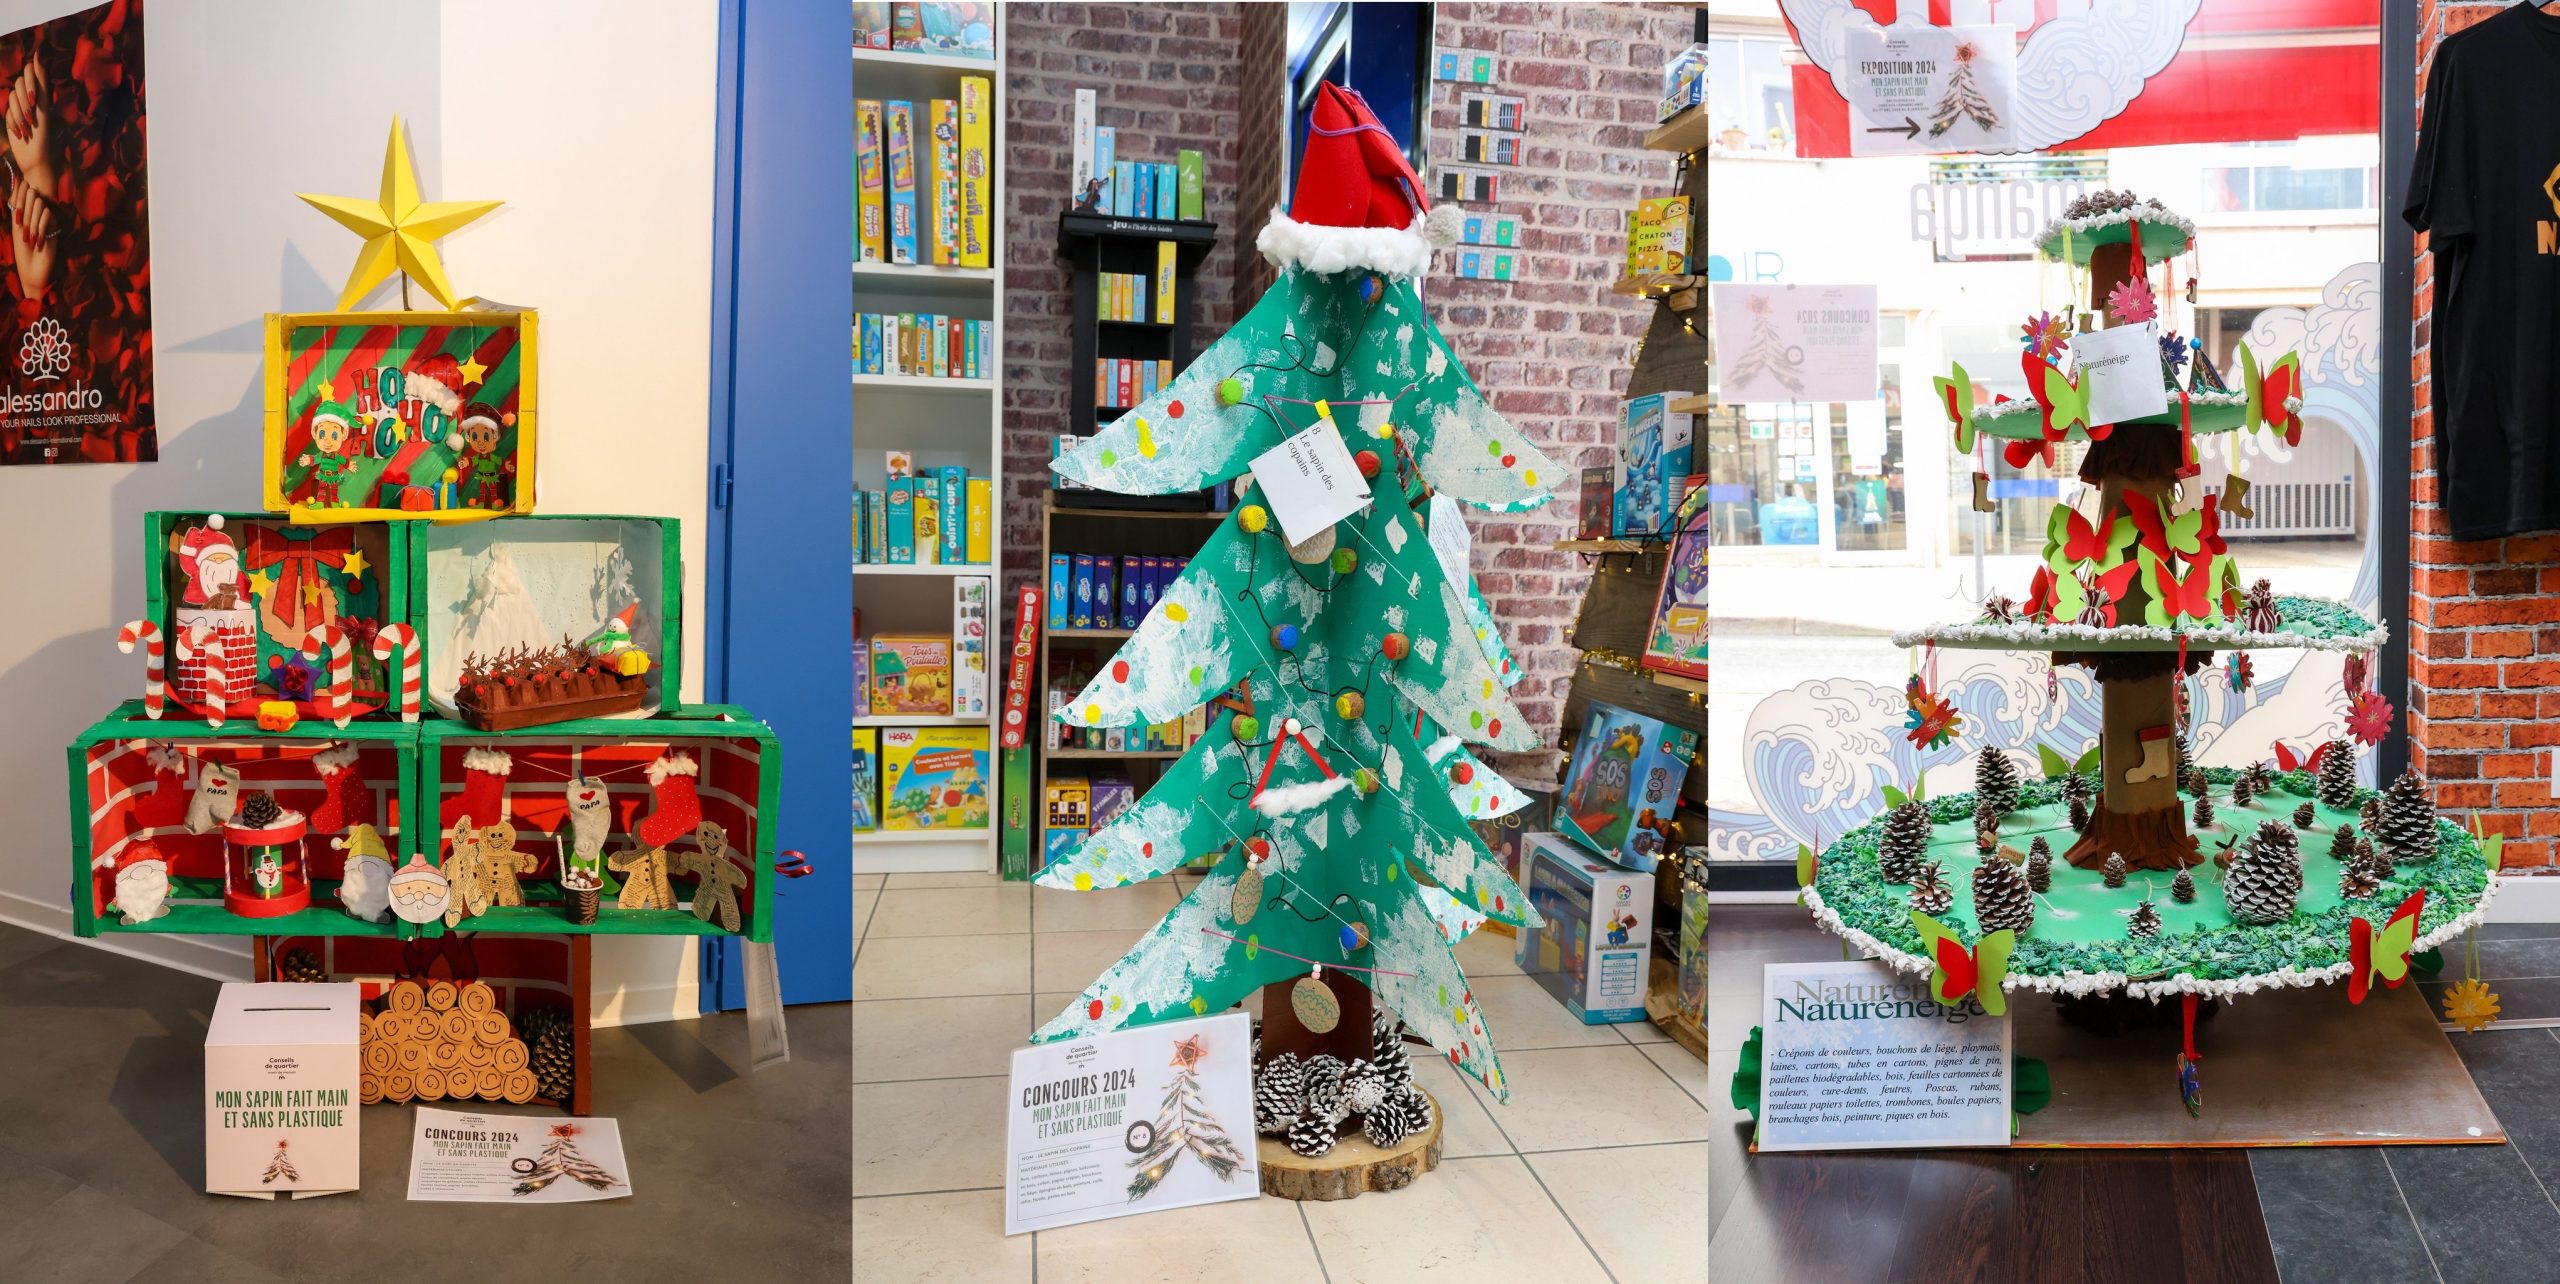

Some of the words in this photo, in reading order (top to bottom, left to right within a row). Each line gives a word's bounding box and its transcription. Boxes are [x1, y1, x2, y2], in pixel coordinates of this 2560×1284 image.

[1861, 61, 1913, 75] EXPOSITION
[1916, 60, 1936, 74] 2024
[1871, 78, 1883, 87] MON
[1884, 77, 1900, 86] SAPIN
[1901, 77, 1913, 86] FAIT
[1914, 77, 1928, 86] MAIN
[1875, 88, 1882, 97] ET
[1883, 87, 1897, 97] SANS
[1898, 87, 1926, 96] PLASTIQUE
[1113, 220, 1127, 230] JEU
[1639, 231, 1672, 240] CHATON
[2074, 349, 2082, 359] 2
[0, 380, 102, 413] alessandro
[1, 419, 20, 428] YOUR
[21, 418, 41, 427] NAILS
[43, 416, 63, 426] LOOK
[64, 413, 121, 424] PROFESSIONAL
[1312, 426, 1321, 435] 8
[1287, 442, 1311, 477] copains
[1299, 434, 1311, 448] Le
[1308, 448, 1325, 474] sapin
[1322, 473, 1334, 491] des
[888, 732, 913, 742] HABA
[915, 757, 942, 765] Couleurs
[1596, 759, 1628, 788] SOS
[1646, 767, 1667, 804] SOS
[1070, 1045, 1094, 1053] Conseils
[1074, 1050, 1098, 1059] quartier
[1778, 1049, 1815, 1059] Crépons
[1818, 1048, 1829, 1057] de
[1832, 1047, 1872, 1056] couleurs,
[1876, 1045, 1917, 1054] bouchons
[1920, 1044, 1931, 1053] de
[1935, 1044, 1958, 1055] liège,
[1961, 1043, 2002, 1054] playmais,
[1770, 1062, 1798, 1071] laines,
[1805, 1062, 1840, 1070] cartons,
[1847, 1060, 1871, 1068] tubes
[1893, 1059, 1928, 1067] cartons,
[1934, 1058, 1964, 1068] pignes
[1969, 1056, 1980, 1065] de
[1985, 1057, 2002, 1067] pin,
[1769, 1074, 1810, 1086] paillettes
[1812, 1072, 1882, 1084] biodégradables,
[1885, 1071, 1906, 1081] bois,
[1907, 1070, 1940, 1082] feuilles
[1942, 1069, 1990, 1079] cartonnées
[1992, 1068, 2003, 1078] de
[1023, 1074, 1098, 1108] CONCOURS
[1103, 1067, 1136, 1093] 2024
[1769, 1088, 1809, 1097] couleurs,
[1821, 1086, 1869, 1096] cure-dents,
[1879, 1084, 1913, 1096] feutres,
[1925, 1083, 1958, 1092] Poscas,
[1970, 1082, 2002, 1091] rubans,
[215, 1090, 242, 1108] MON
[246, 1090, 282, 1108] SAPIN
[287, 1090, 313, 1107] FAIT
[317, 1089, 348, 1106] MAIN
[1769, 1101, 1807, 1110] rouleaux
[1809, 1100, 1843, 1112] papiers
[1845, 1099, 1882, 1108] toilettes,
[1885, 1097, 1933, 1107] trombones,
[1936, 1096, 1965, 1105] boules
[1967, 1095, 2002, 1107] papiers,
[1033, 1106, 1052, 1123] MON
[1054, 1100, 1081, 1119] SAPIN
[1083, 1096, 1101, 1114] FAIT
[1104, 1092, 1126, 1110] MAIN
[224, 1111, 238, 1128] ET
[242, 1111, 274, 1128] SANS
[278, 1110, 343, 1128] PLASTIQUE
[1038, 1123, 1048, 1139] ET
[1051, 1118, 1074, 1137] SANS
[1076, 1110, 1123, 1132] PLASTIQUE
[1768, 1114, 1819, 1125] branchages
[1821, 1113, 1842, 1122] bois,
[1844, 1112, 1883, 1124] peinture,
[1884, 1111, 1914, 1123] piques
[1929, 1110, 1950, 1119] bois.
[425, 1127, 487, 1142] CONCOURS
[491, 1132, 518, 1142] 2024
[433, 1140, 448, 1148] MON
[451, 1141, 472, 1149] SAPIN
[474, 1142, 489, 1150] FAIT
[493, 1142, 511, 1151] MAIN
[437, 1148, 445, 1157] ET
[448, 1149, 467, 1157] SANS
[469, 1149, 508, 1158] PLASTIQUE
